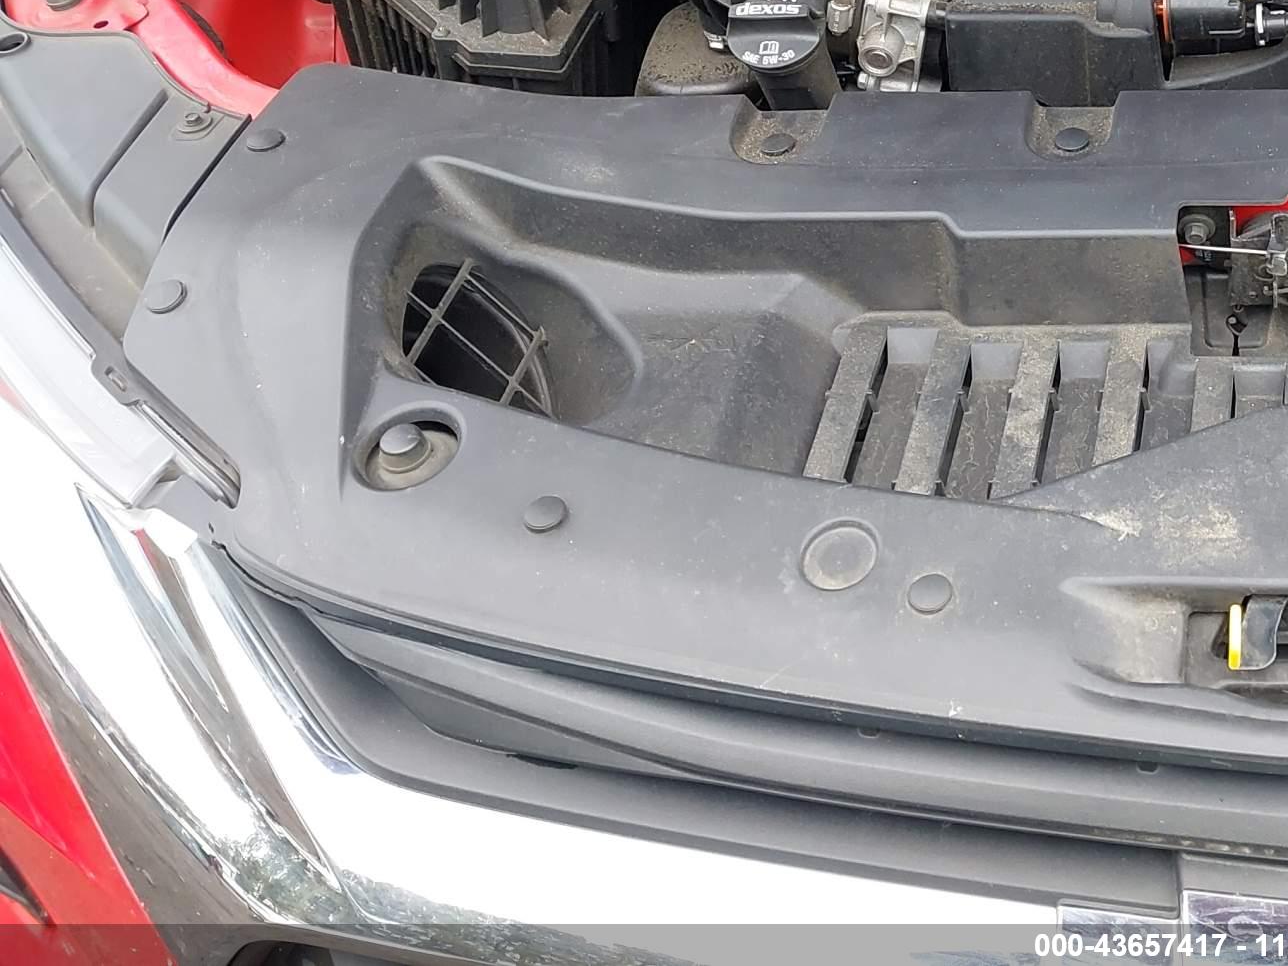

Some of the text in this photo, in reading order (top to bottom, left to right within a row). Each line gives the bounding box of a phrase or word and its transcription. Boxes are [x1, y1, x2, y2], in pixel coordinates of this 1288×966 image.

[736, 2, 802, 17] dexos
[742, 50, 796, 66] SAE 5W-30
